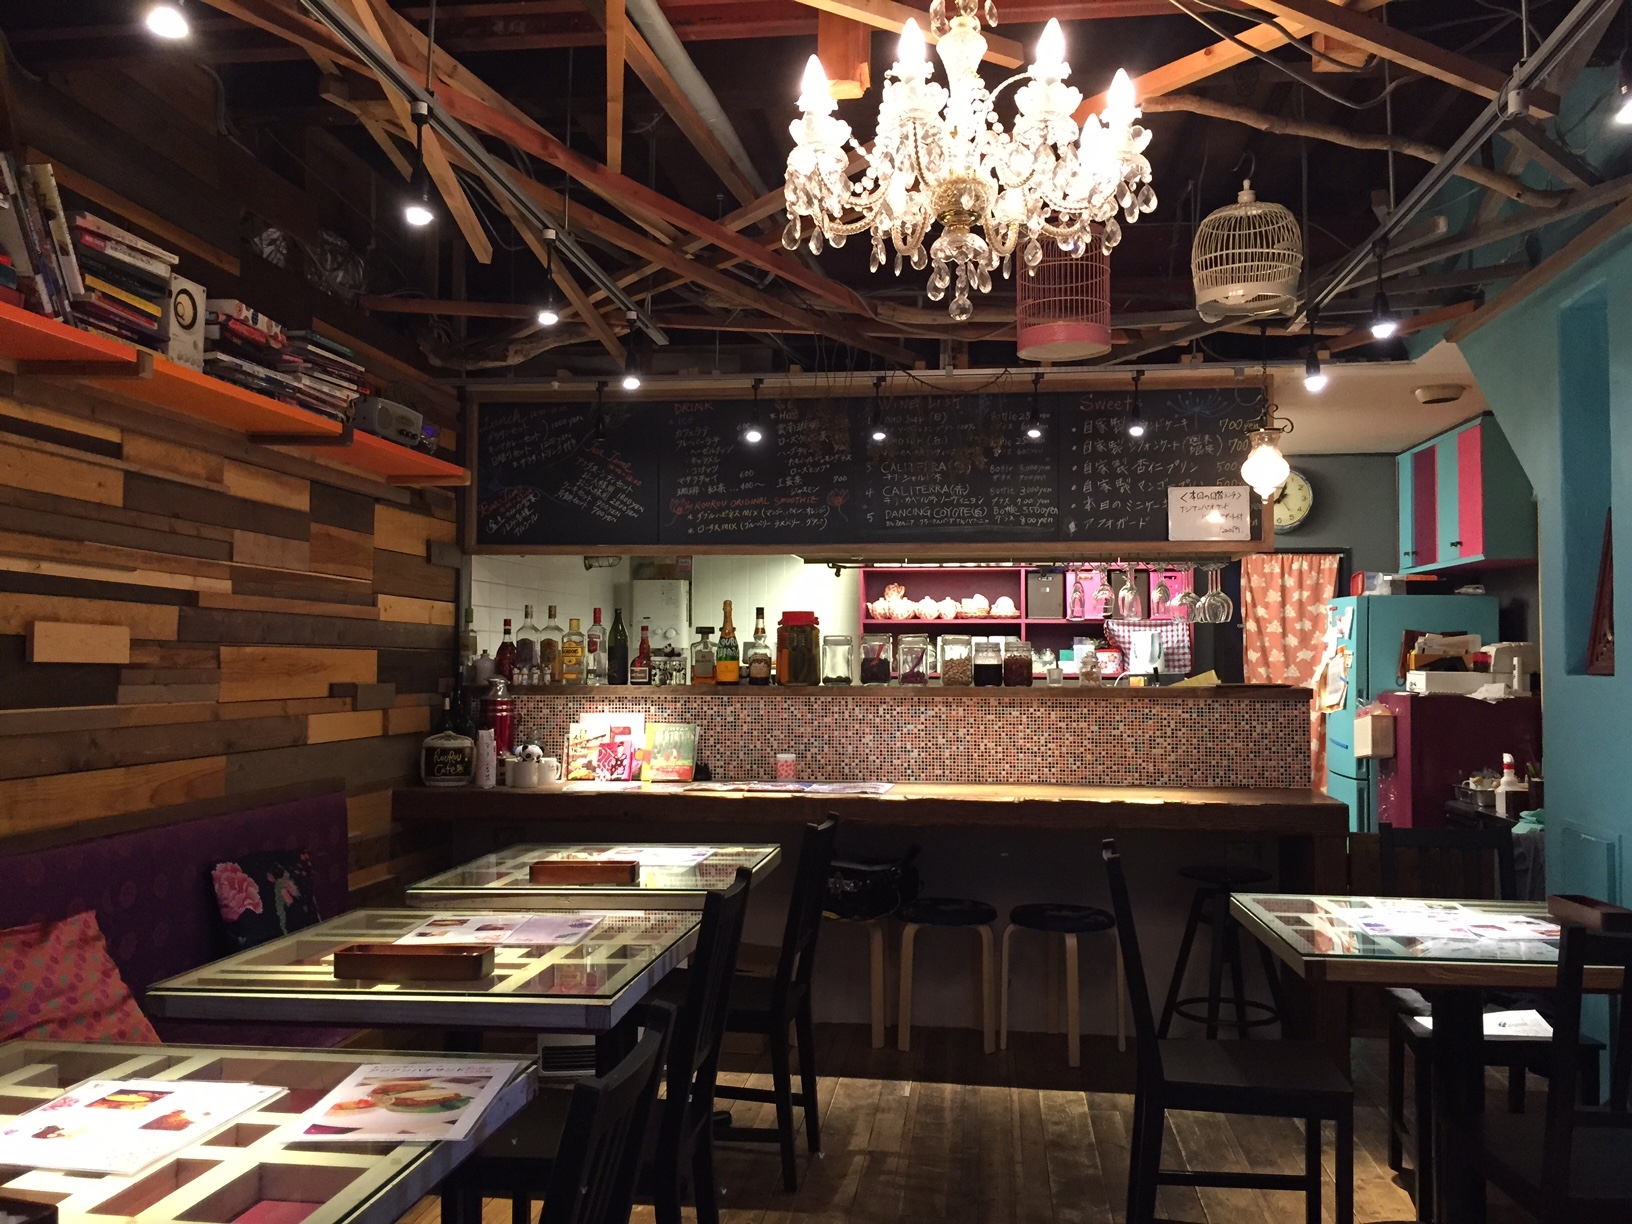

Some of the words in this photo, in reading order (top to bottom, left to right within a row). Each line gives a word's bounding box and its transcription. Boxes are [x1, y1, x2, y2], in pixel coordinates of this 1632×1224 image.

[674, 401, 714, 415] DRINK
[739, 470, 755, 479] 600
[989, 464, 1014, 474] Bottle
[832, 475, 848, 483] 700
[866, 487, 875, 499] 4
[989, 486, 1016, 496] Bottle
[1019, 486, 1052, 497] 3000yen
[694, 499, 728, 511] ROUROU
[730, 496, 770, 508] ORIGINAL
[774, 494, 819, 506] SMOOTHIE
[867, 512, 875, 523] 5
[885, 506, 932, 520] DANCING
[993, 505, 1021, 516] Bottle
